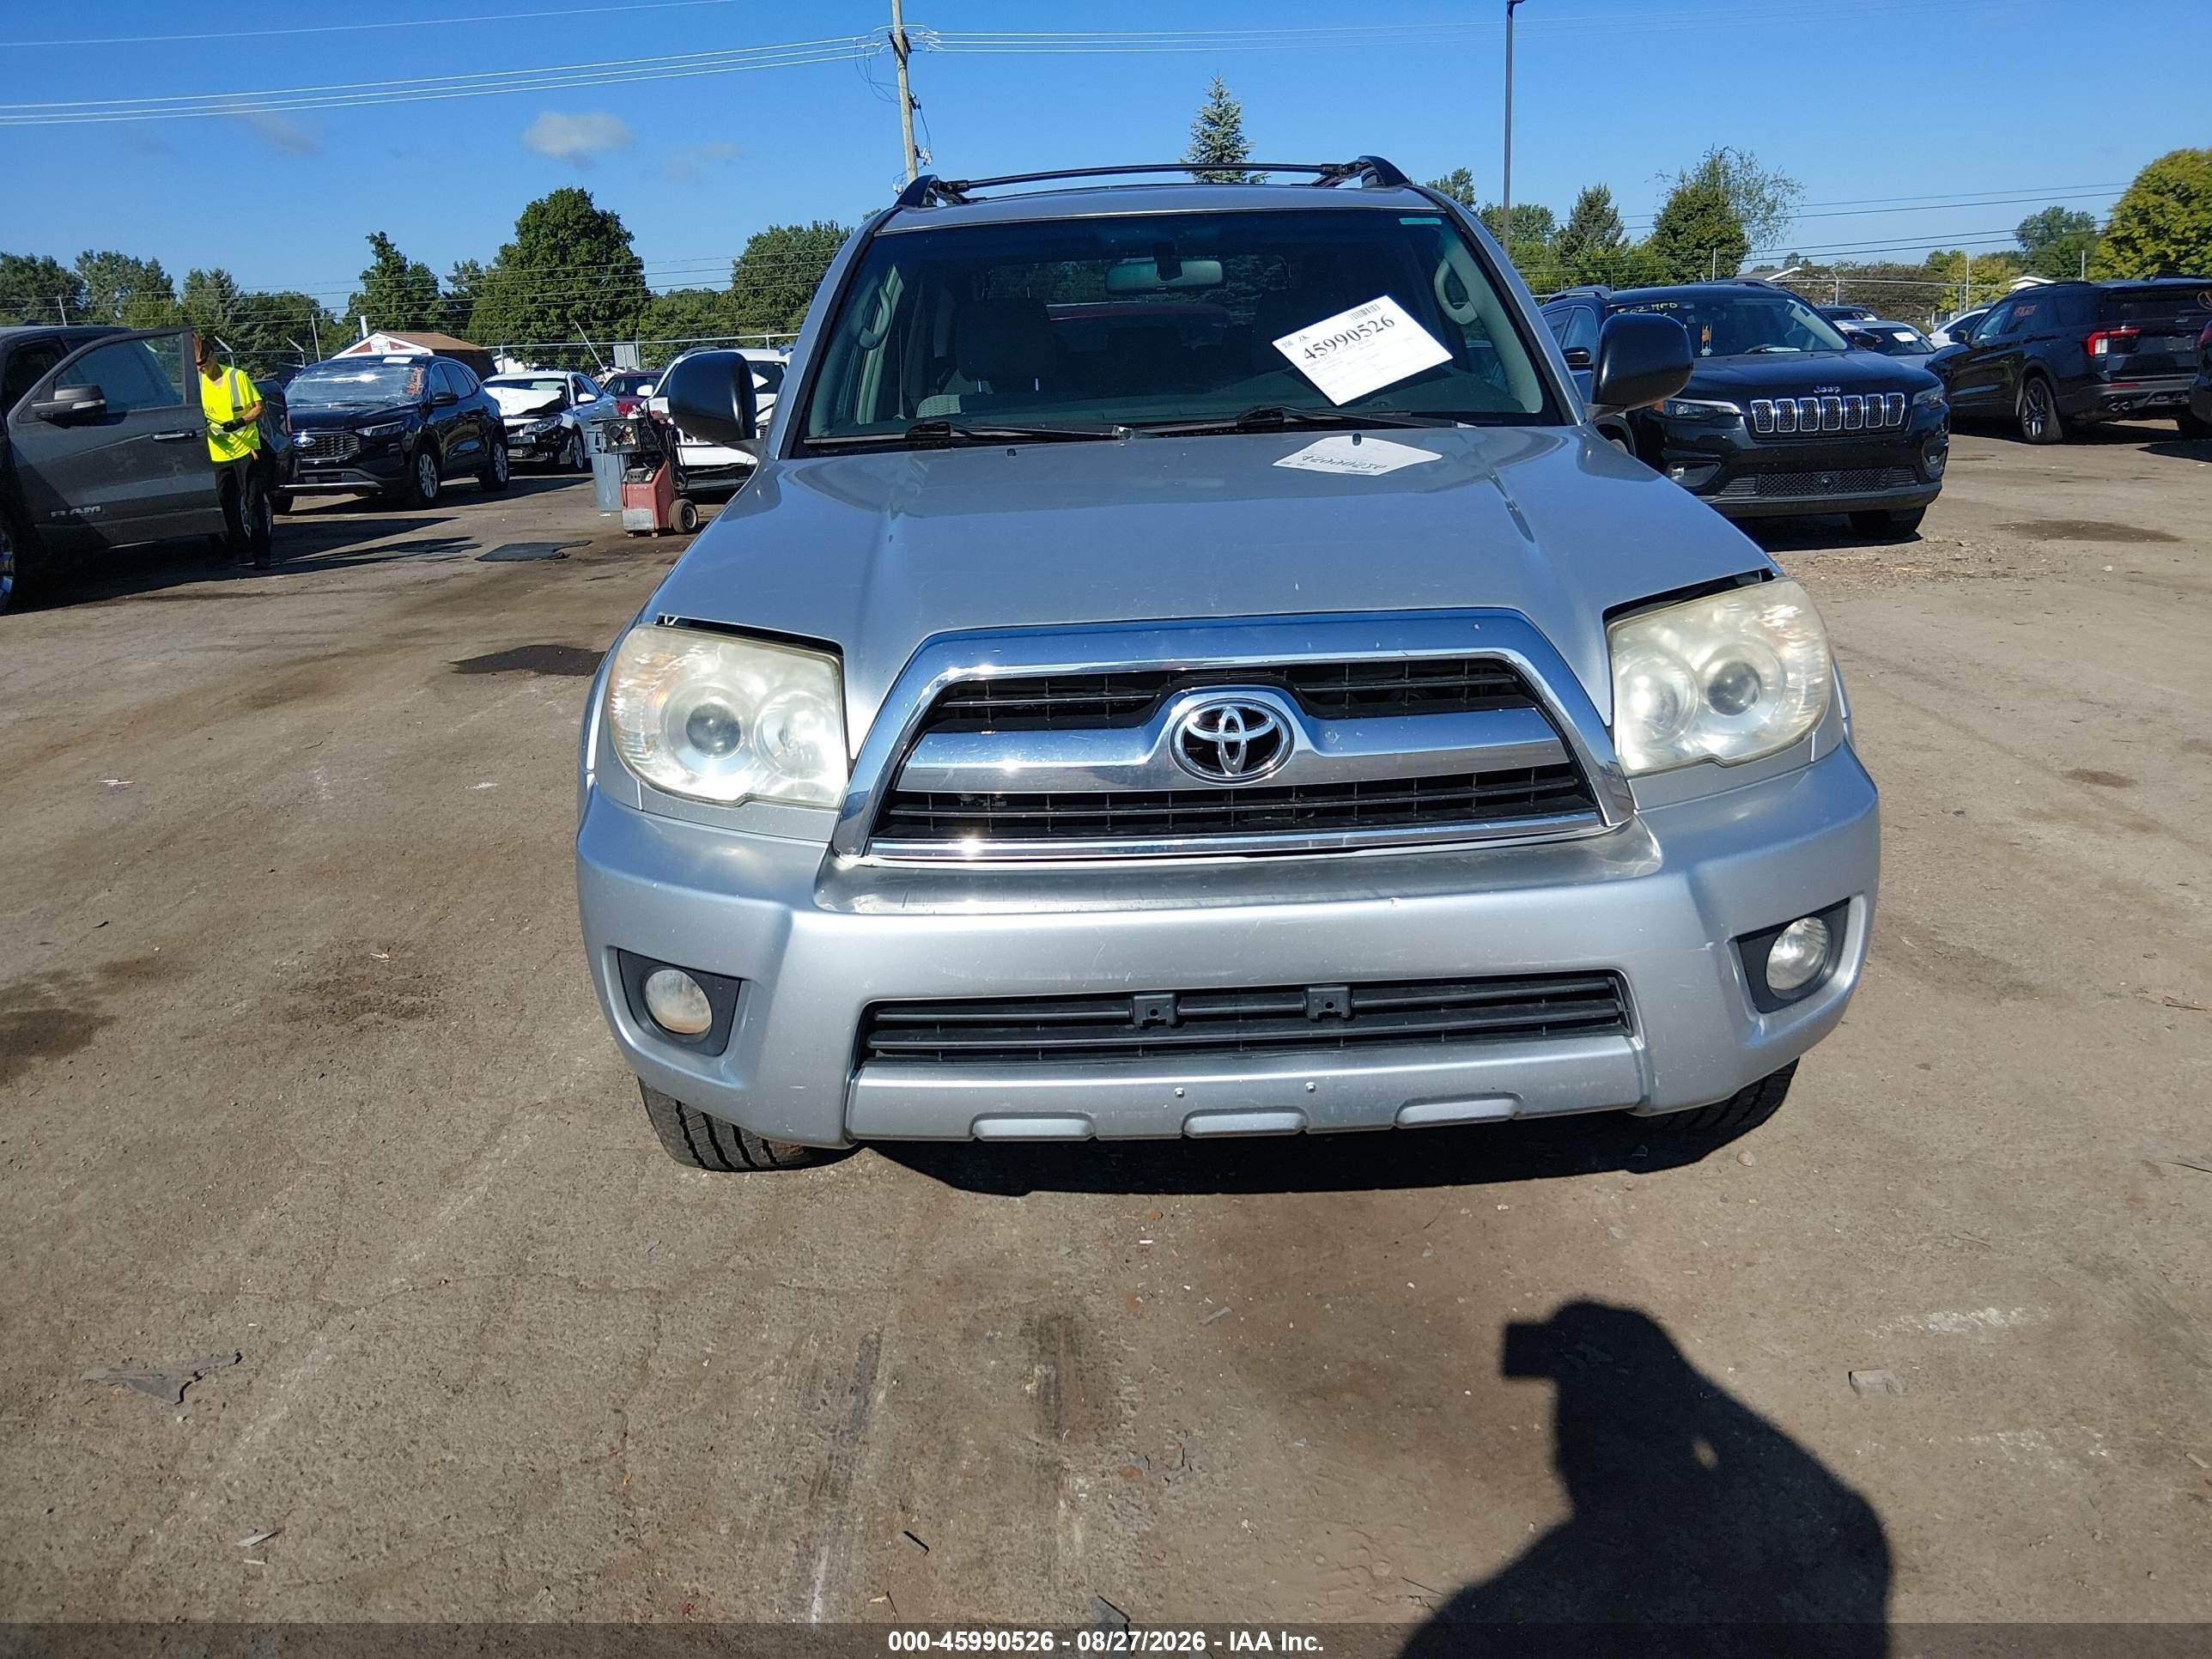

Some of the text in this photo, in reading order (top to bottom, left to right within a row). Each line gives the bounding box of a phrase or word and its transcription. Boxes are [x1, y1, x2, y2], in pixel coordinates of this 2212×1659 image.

[1304, 314, 1395, 359] 45990526
[1814, 385, 1841, 394] Jeep
[51, 506, 101, 517] RAM
